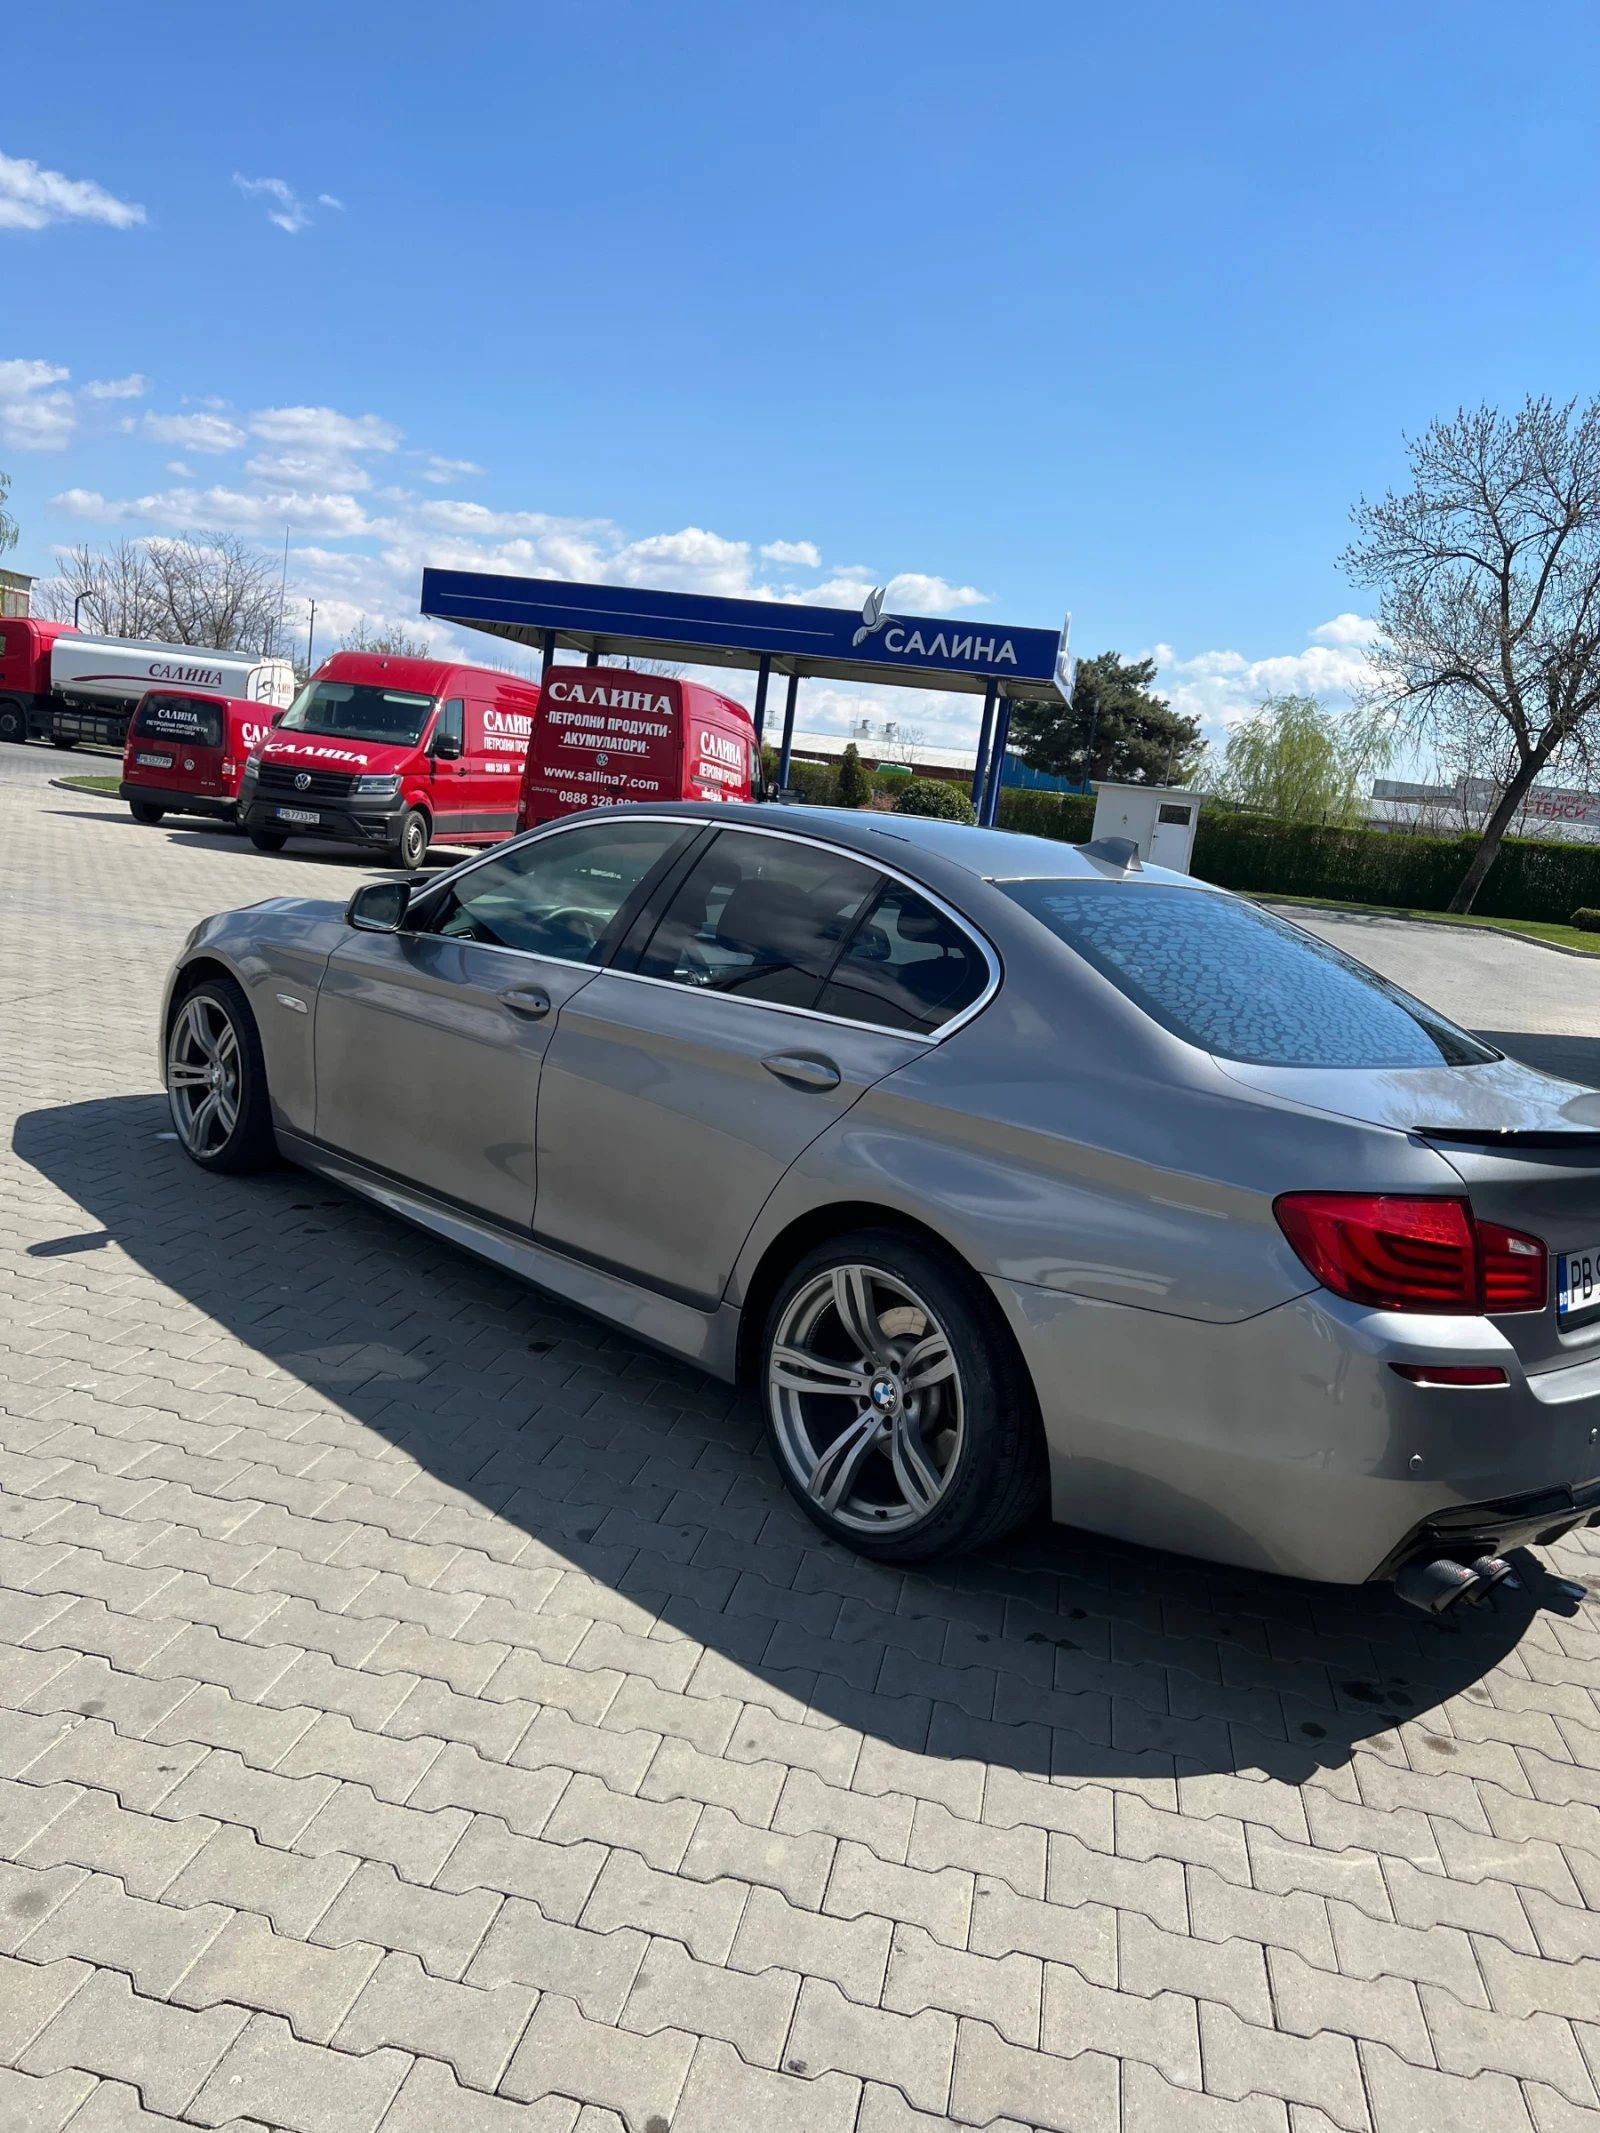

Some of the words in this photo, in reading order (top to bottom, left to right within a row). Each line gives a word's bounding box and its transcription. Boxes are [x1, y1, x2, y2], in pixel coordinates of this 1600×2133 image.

[885, 628, 1017, 665] САЛИНА
[149, 663, 222, 685] САЛИНА
[548, 682, 674, 715] САЛИНА
[158, 709, 198, 722] САЛИНА
[483, 710, 532, 735] САЛИН
[264, 743, 368, 766] САЛИНА
[701, 731, 741, 767] САЛИНА
[544, 767, 659, 791] www.sallina7.com
[559, 791, 588, 805] 0888
[1571, 1257, 1593, 1304] PB
